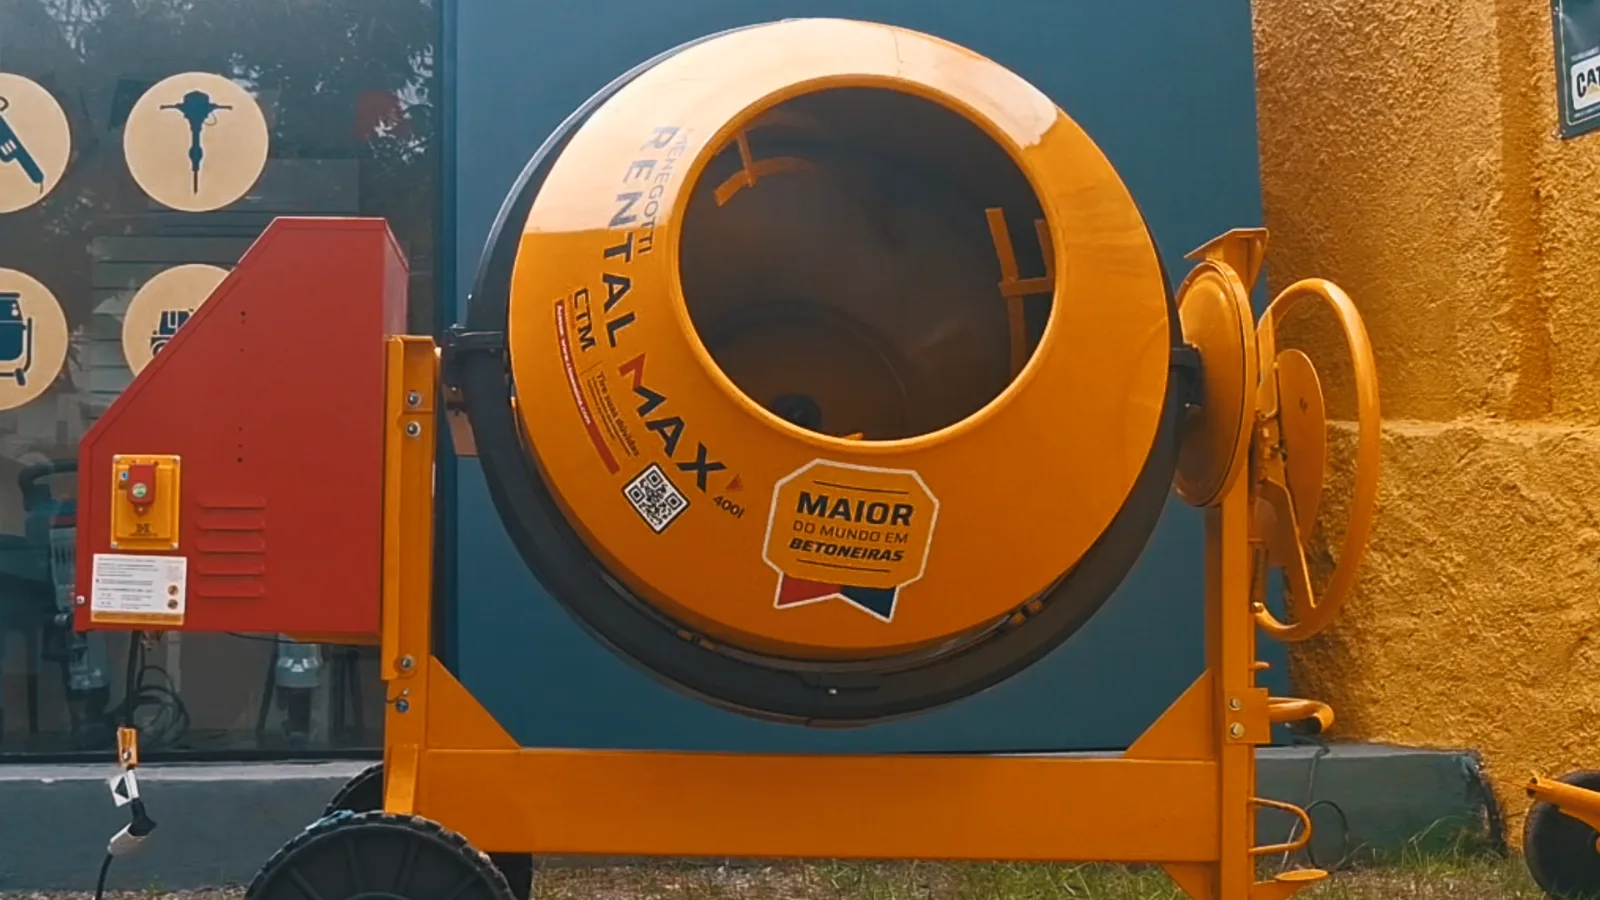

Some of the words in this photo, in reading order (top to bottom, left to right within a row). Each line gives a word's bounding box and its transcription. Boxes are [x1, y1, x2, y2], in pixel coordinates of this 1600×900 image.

[638, 128, 694, 254] MENEGOTTI
[602, 126, 681, 347] RENTAL
[574, 288, 596, 352] CTM
[618, 352, 727, 493] MAX
[793, 520, 816, 534] DO
[820, 525, 881, 543] MUNDO
[884, 532, 909, 544] EM
[797, 491, 913, 526] MAIOR
[789, 538, 904, 561] BETONEIRAS
